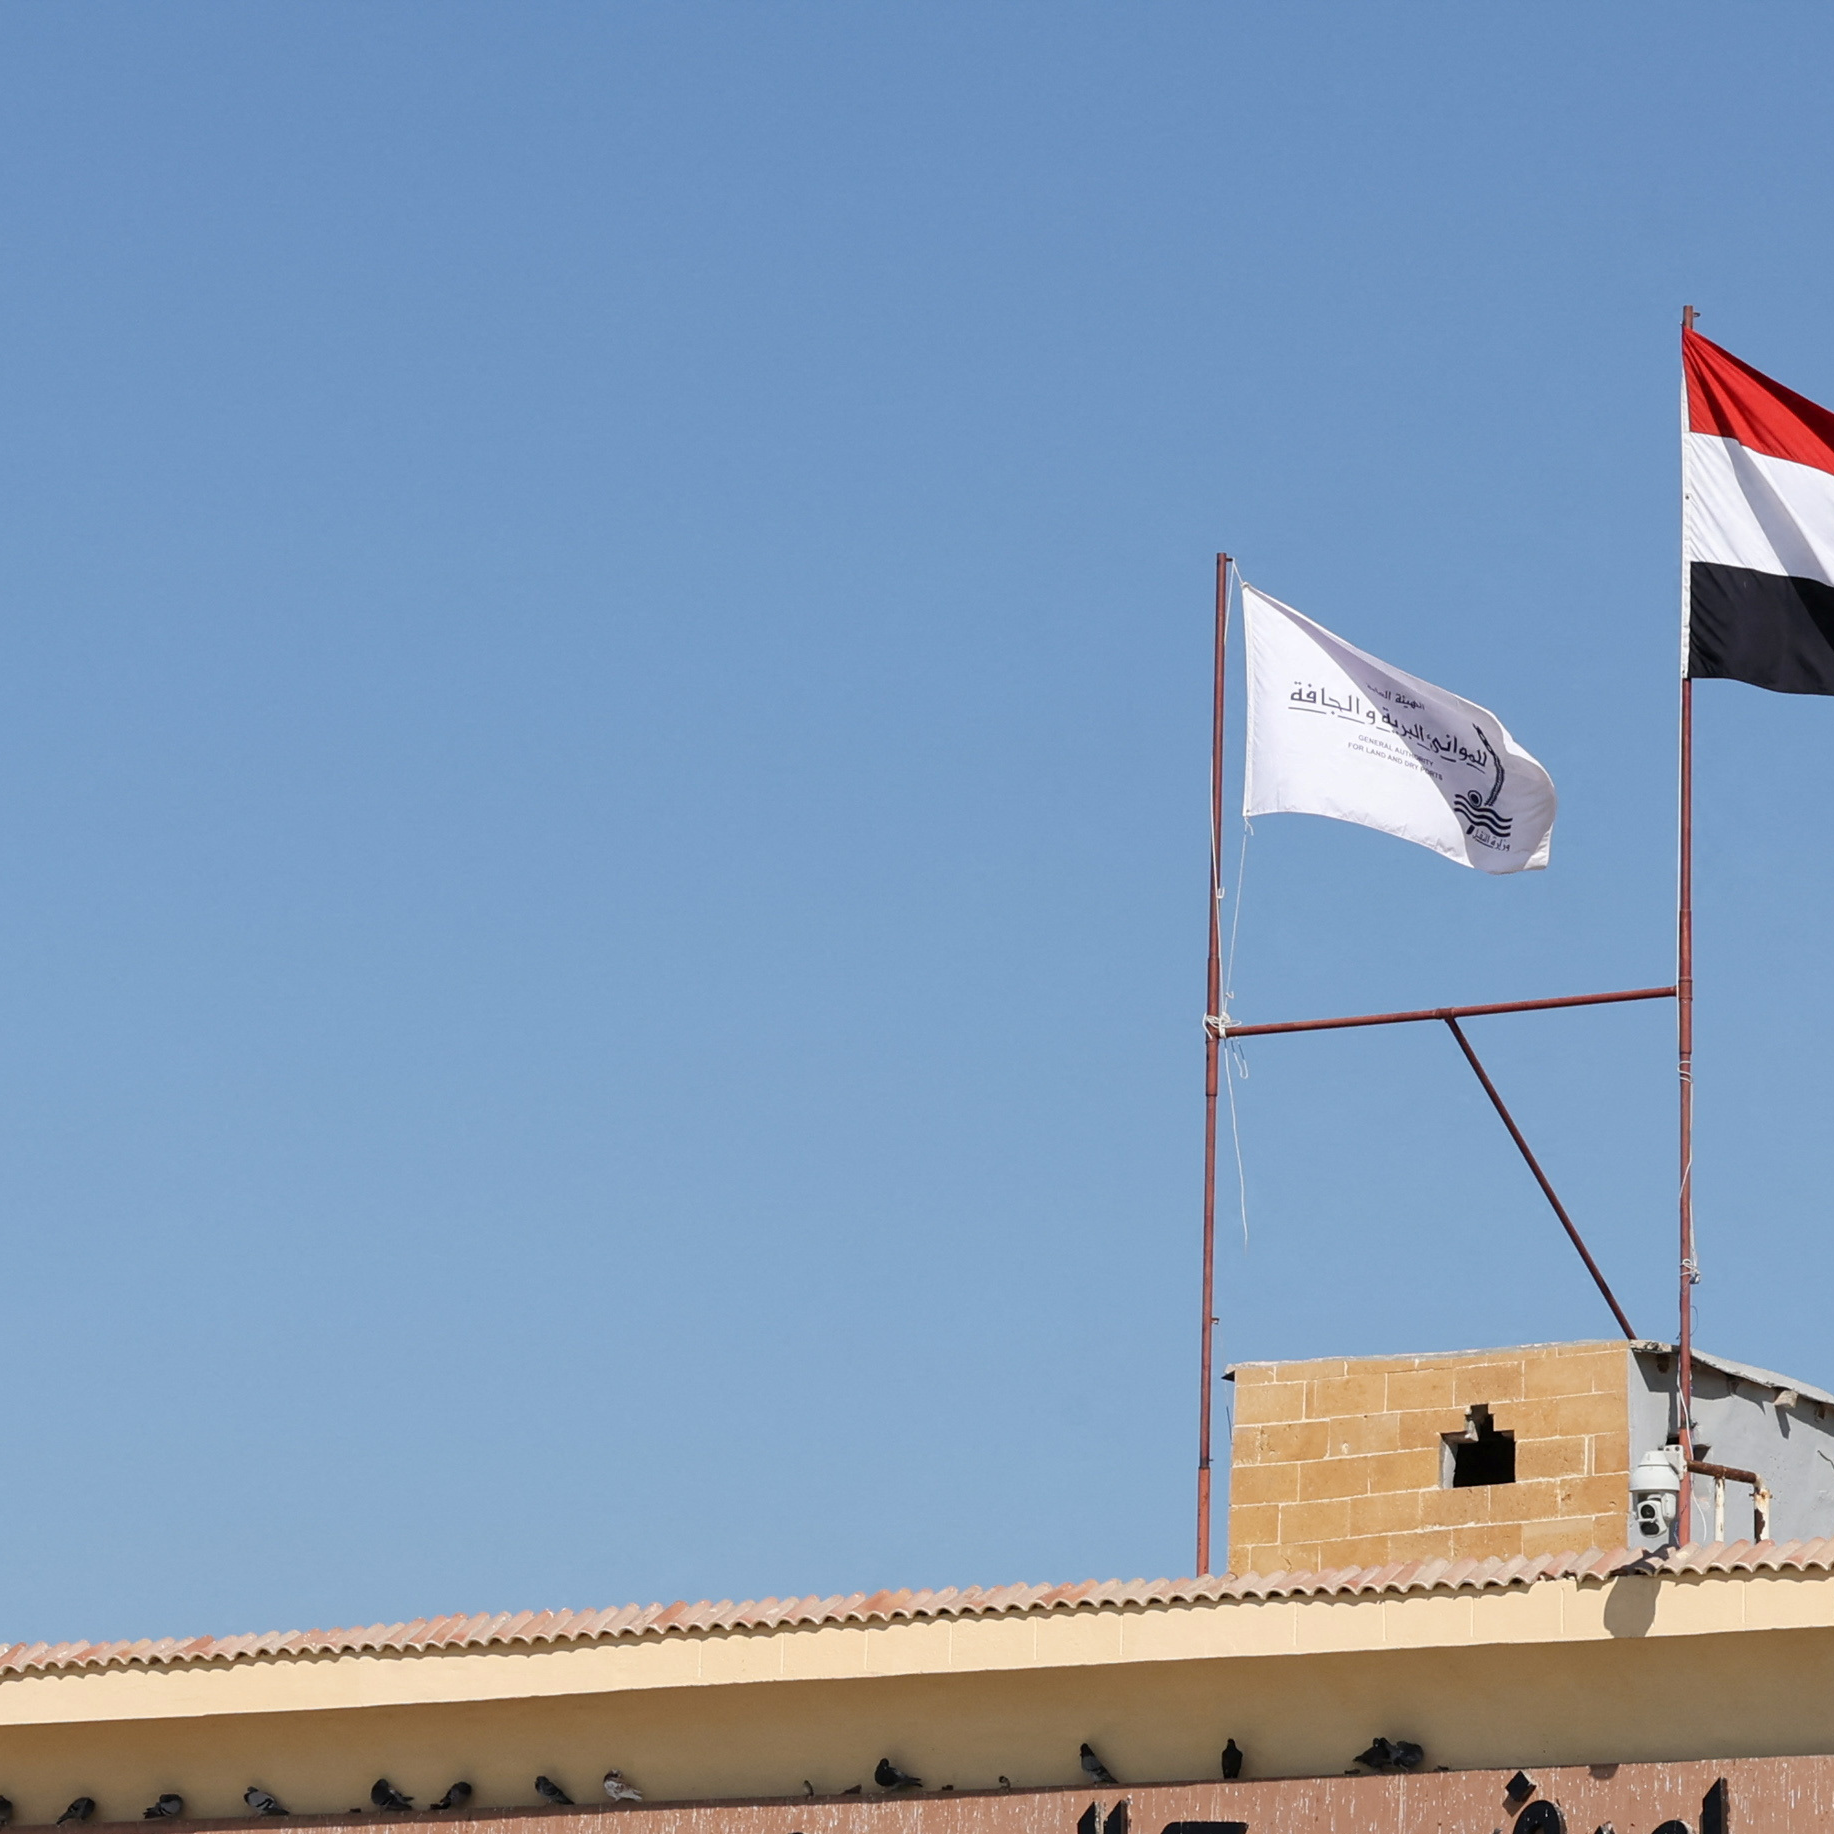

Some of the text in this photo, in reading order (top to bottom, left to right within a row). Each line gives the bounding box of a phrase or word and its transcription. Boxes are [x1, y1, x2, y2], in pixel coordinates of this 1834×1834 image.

[1348, 742, 1444, 782] FOR LAND AND DRY PORTS
[1358, 734, 1435, 767] GENERAL AUTHORITY
